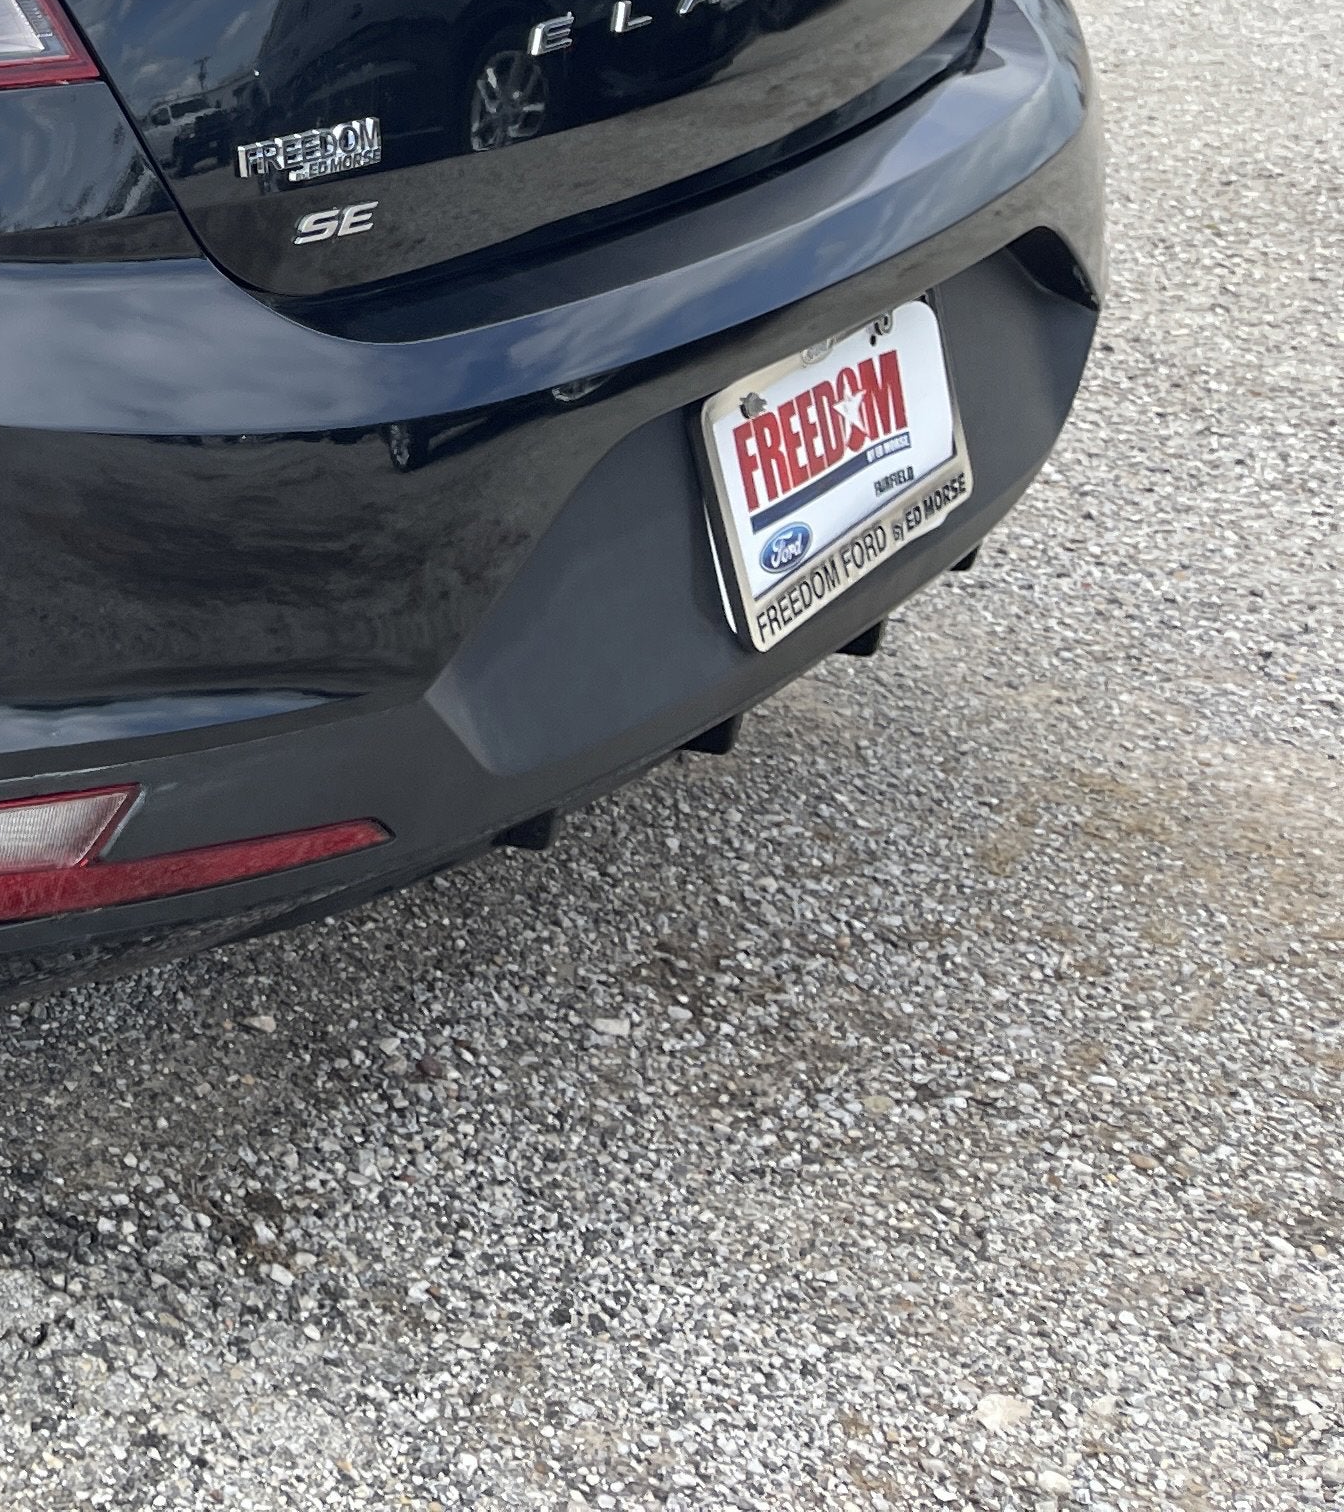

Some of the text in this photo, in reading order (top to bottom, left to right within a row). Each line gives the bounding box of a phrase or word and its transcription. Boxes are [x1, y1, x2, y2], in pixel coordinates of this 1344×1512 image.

[237, 117, 381, 178] FREEDOM
[330, 148, 382, 173] MORSE
[293, 200, 379, 245] SE
[733, 349, 908, 513] FREEDOM
[756, 559, 841, 643] FREEDOM
[841, 524, 887, 578] FORD
[905, 505, 922, 531] ED
[923, 471, 966, 520] MORSE
[770, 531, 802, 569] Ford
